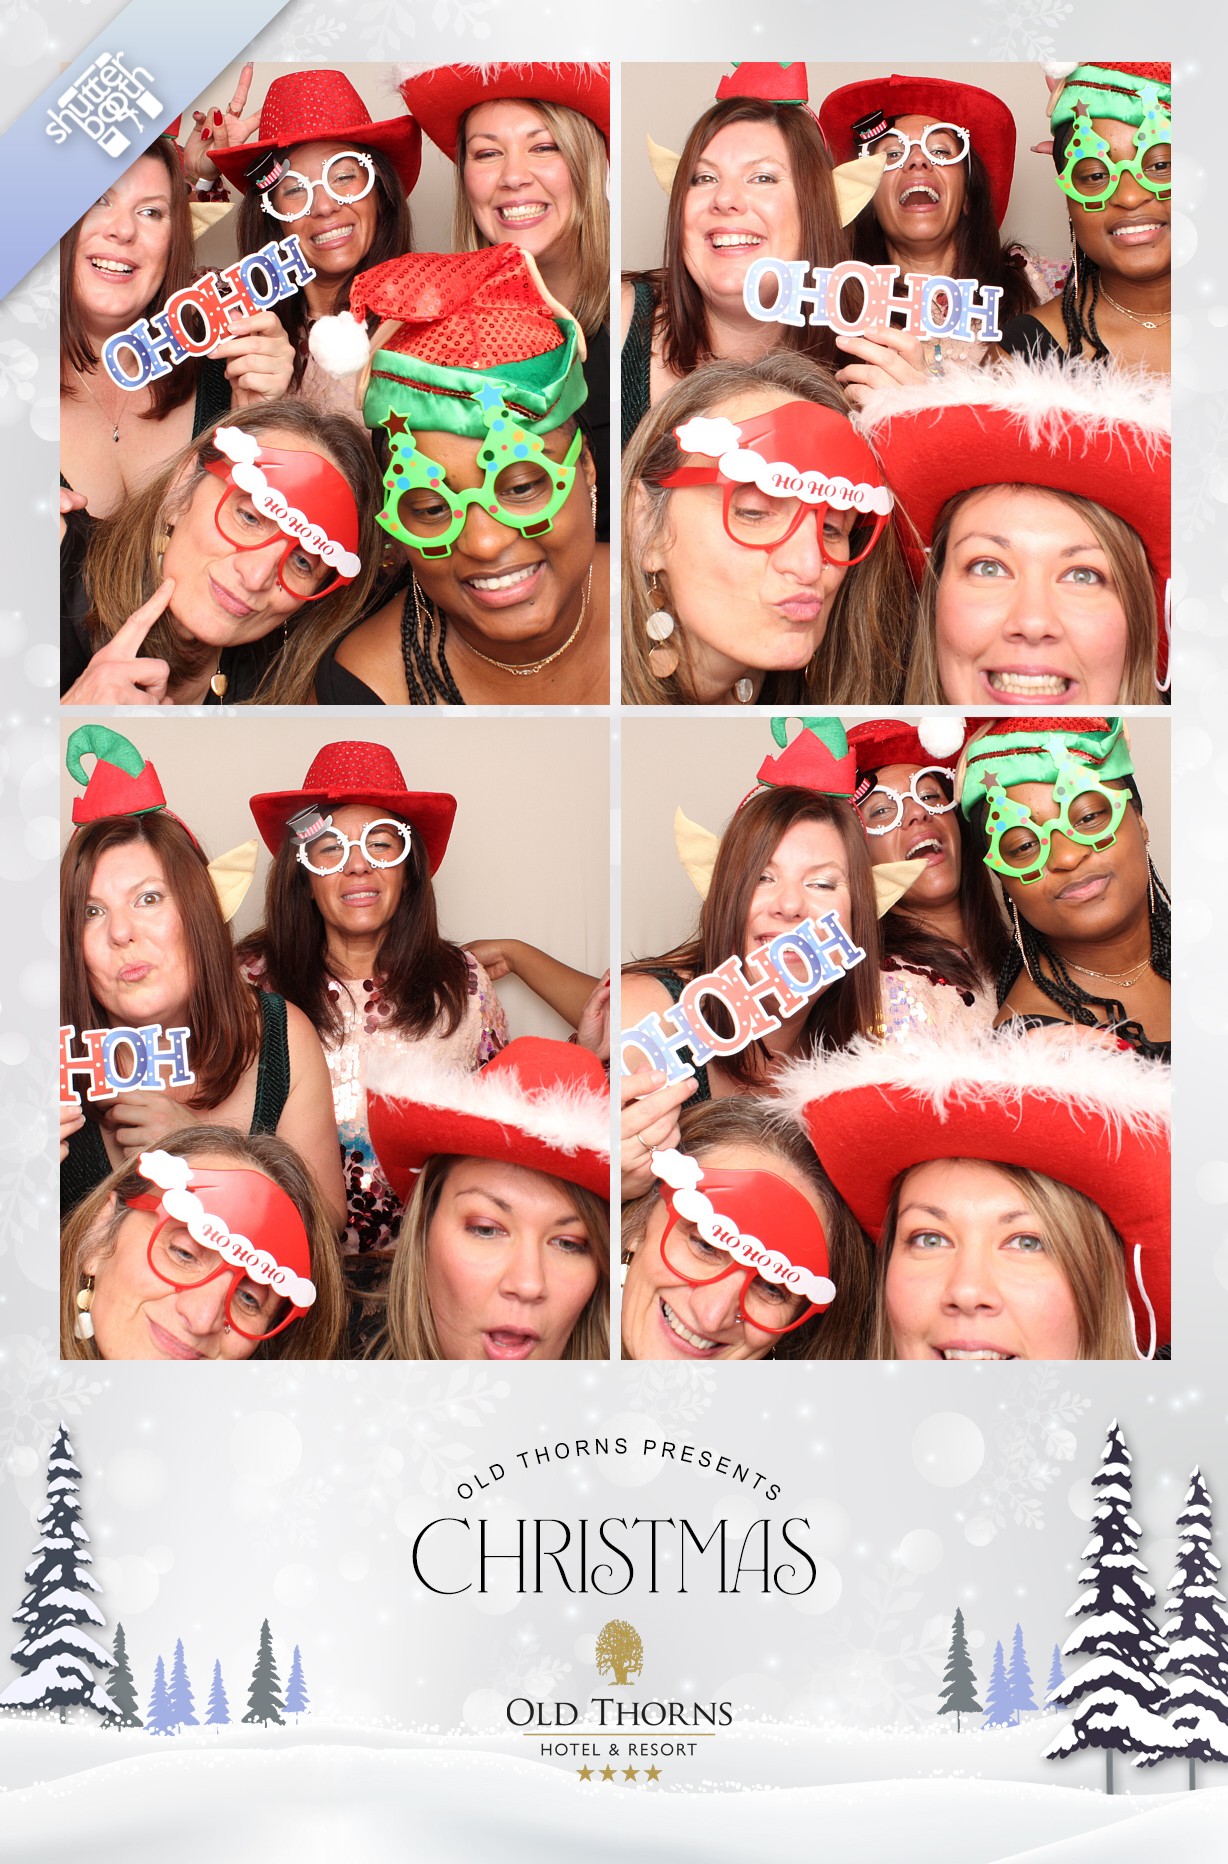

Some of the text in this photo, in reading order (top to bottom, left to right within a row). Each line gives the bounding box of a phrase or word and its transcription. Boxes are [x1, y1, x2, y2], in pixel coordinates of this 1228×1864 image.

[772, 473, 864, 503] HO HO HO
[264, 496, 334, 555] HO HO HO
[203, 1223, 285, 1284] HO HO HO
[712, 1224, 800, 1283] HO HO HO
